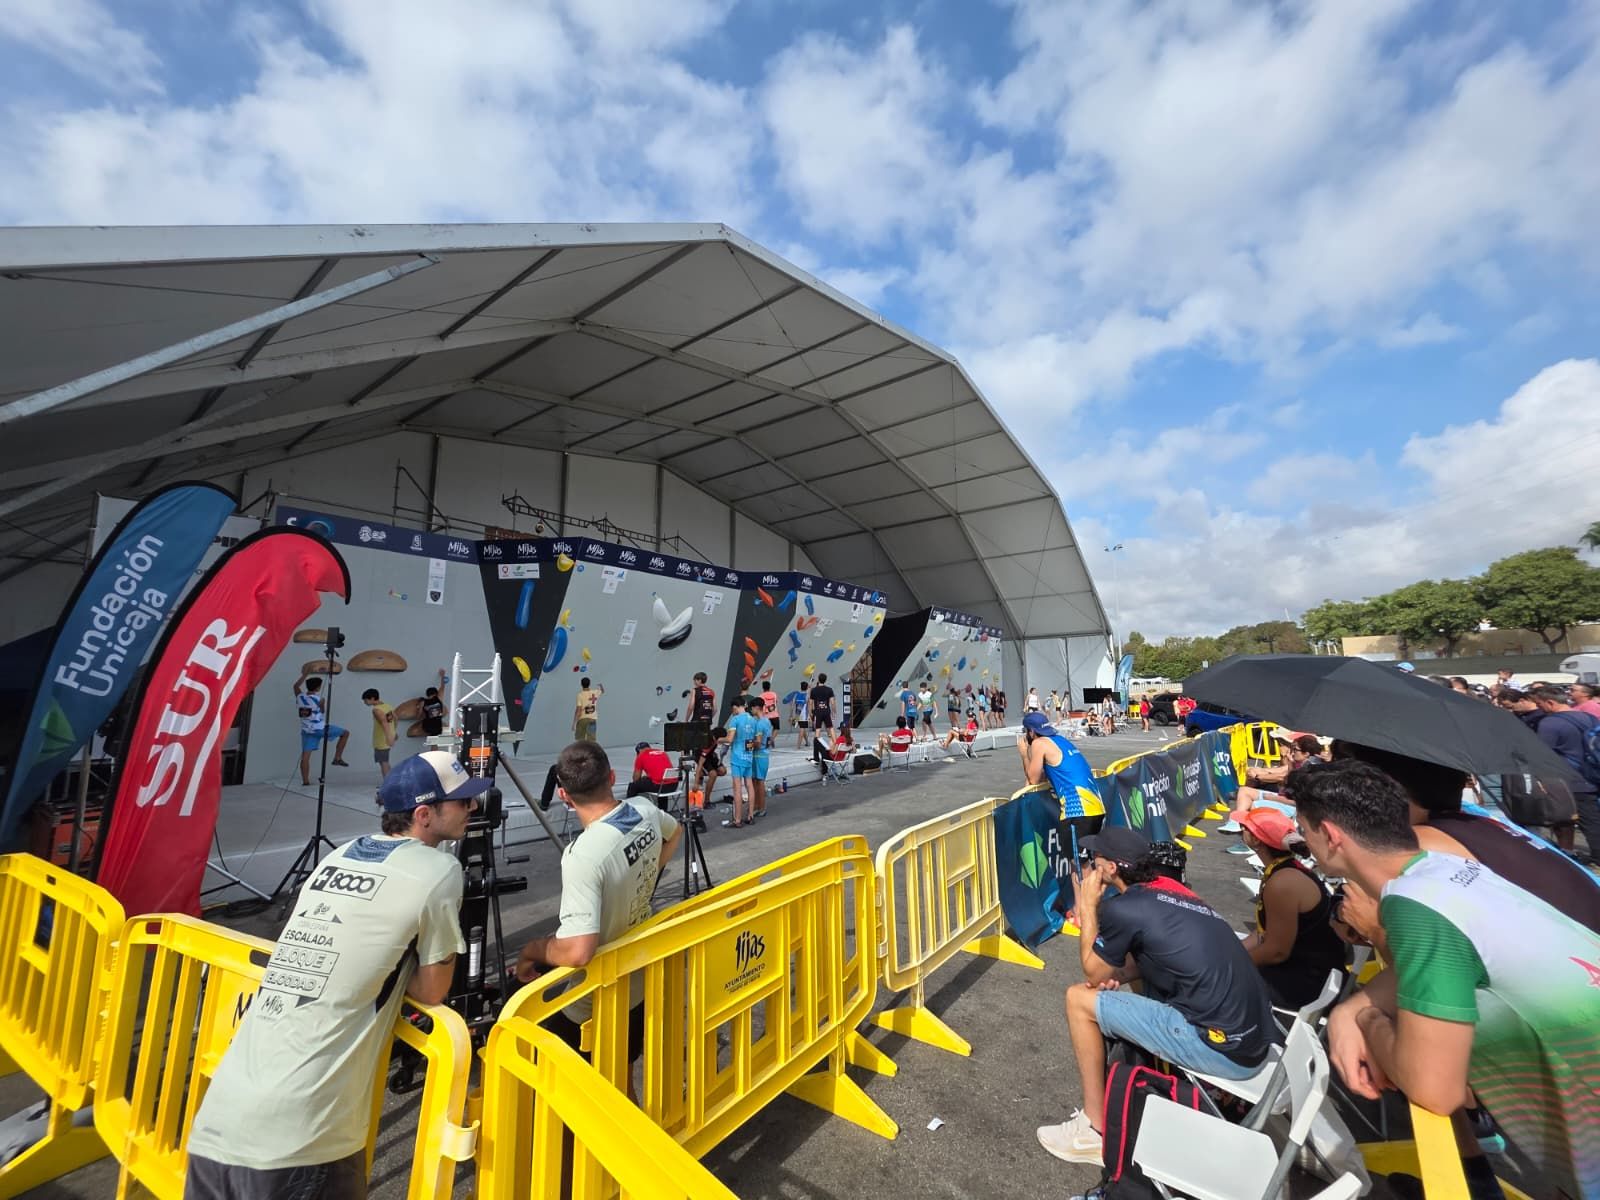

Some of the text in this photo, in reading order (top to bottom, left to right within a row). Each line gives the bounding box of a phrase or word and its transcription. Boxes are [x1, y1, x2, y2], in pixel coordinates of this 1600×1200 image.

[447, 541, 470, 555] Mijas
[483, 544, 503, 557] Mijas
[517, 543, 537, 555] Mijas
[552, 541, 573, 554] Mijas
[586, 544, 605, 556] Mijas
[54, 534, 164, 689] Fundación
[80, 587, 168, 697] Unicaja
[136, 618, 248, 808] SUR
[329, 873, 376, 894] 8000
[284, 929, 334, 947] ESCALADA
[274, 945, 328, 969] BLOQUE
